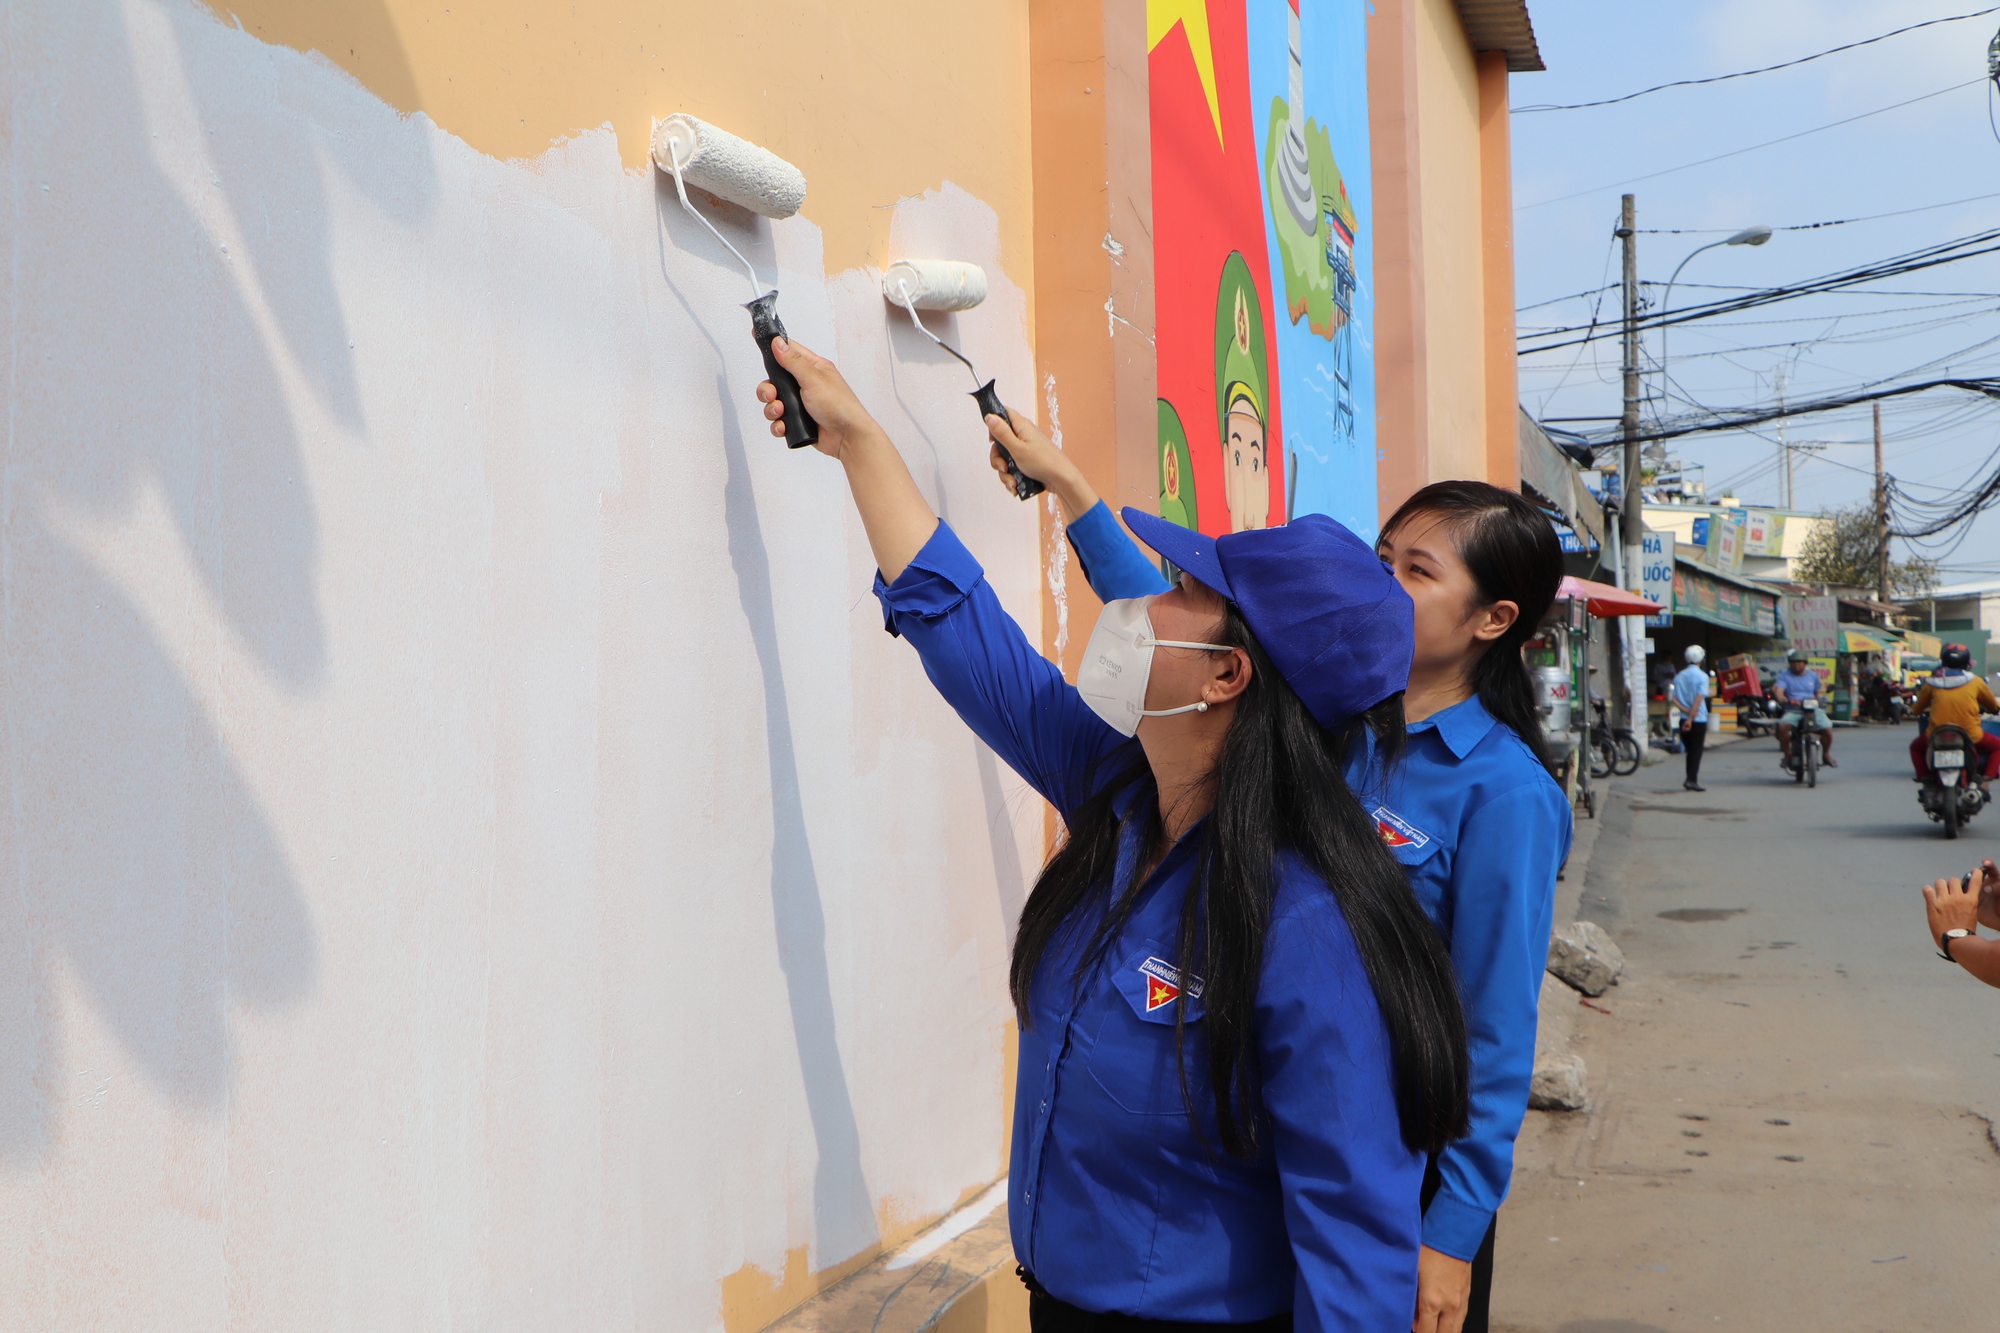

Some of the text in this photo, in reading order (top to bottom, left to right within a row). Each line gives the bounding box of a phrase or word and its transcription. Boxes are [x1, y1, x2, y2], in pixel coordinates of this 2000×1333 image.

[1642, 534, 1662, 554] HÀ
[1642, 560, 1672, 582] UỐC
[1792, 599, 1835, 612] CAMERA
[1793, 618, 1805, 631] VI
[1823, 636, 1836, 649] IN
